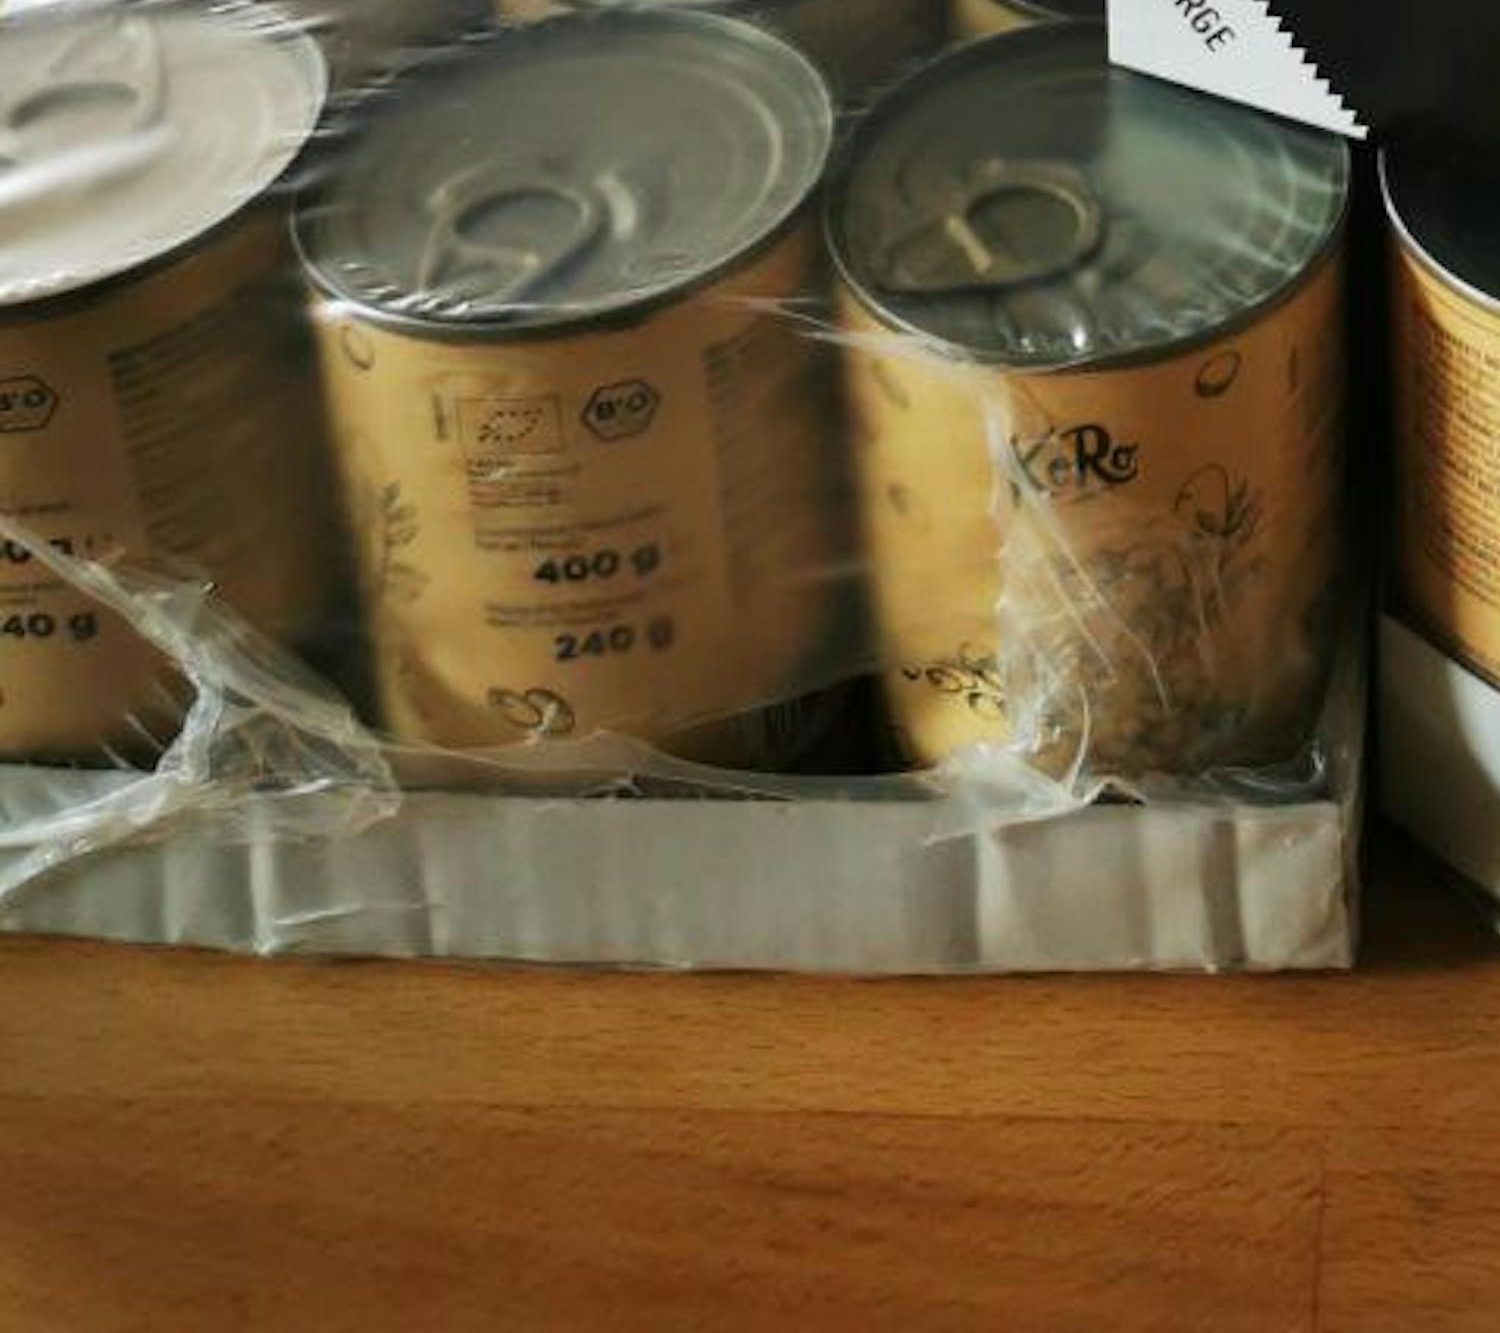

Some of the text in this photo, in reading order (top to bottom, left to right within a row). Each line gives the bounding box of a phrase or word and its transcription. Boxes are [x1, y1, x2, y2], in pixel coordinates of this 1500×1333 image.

[533, 541, 662, 585] 400 g
[553, 623, 636, 663] 240
